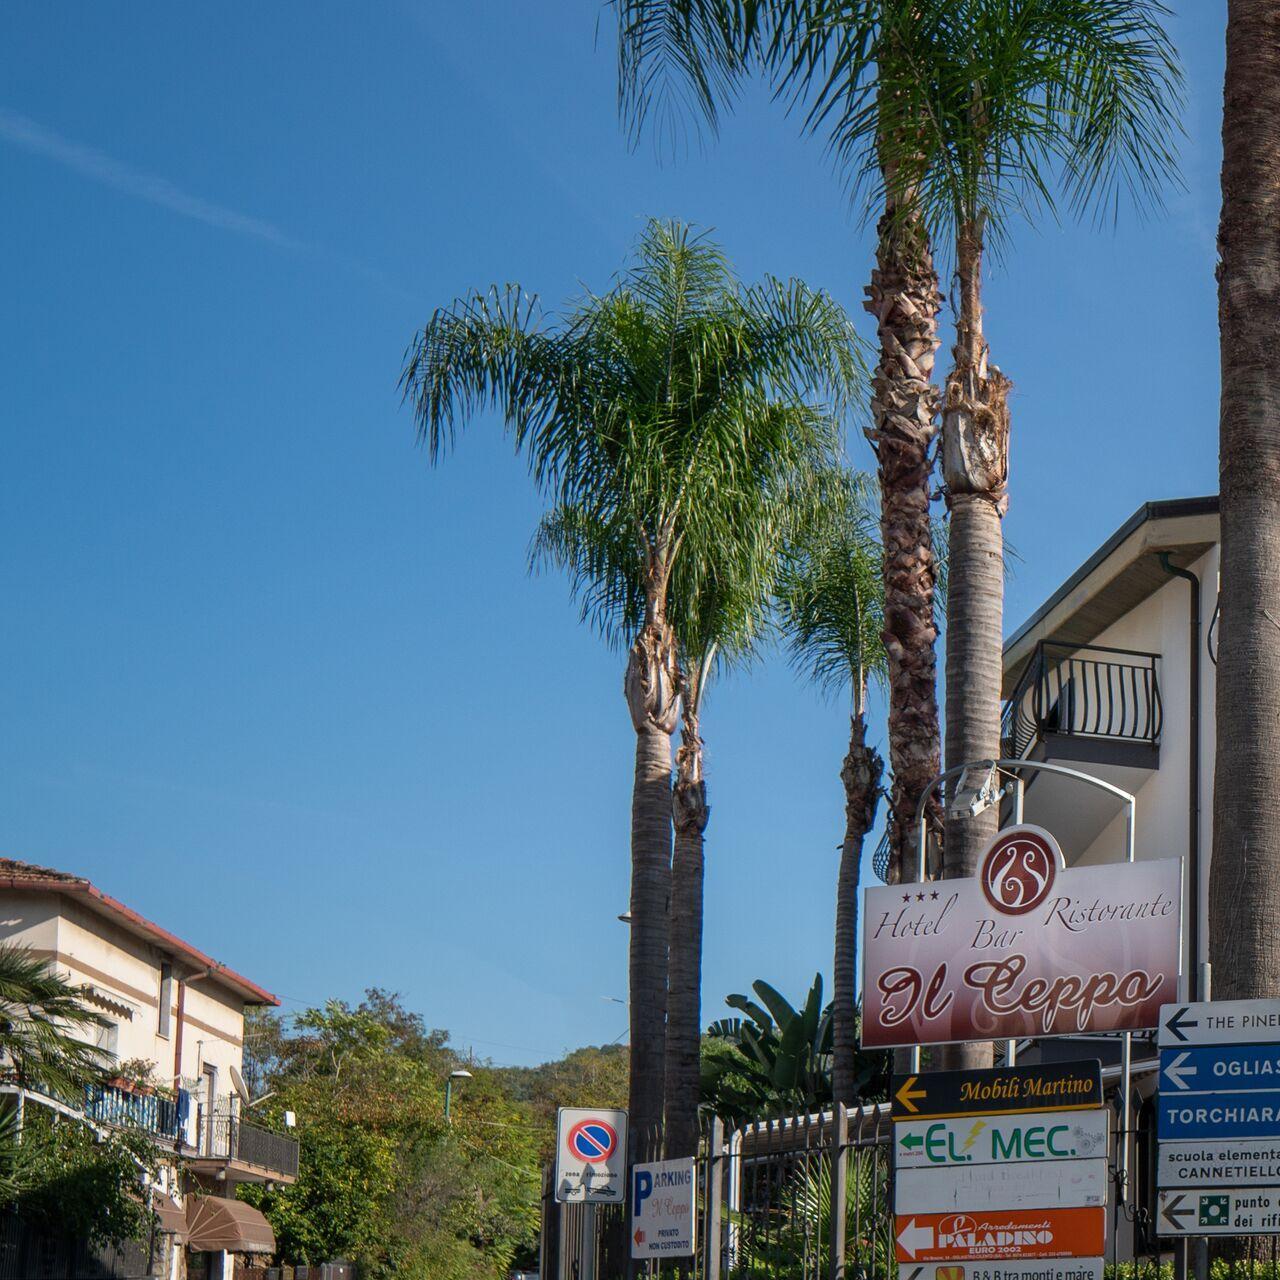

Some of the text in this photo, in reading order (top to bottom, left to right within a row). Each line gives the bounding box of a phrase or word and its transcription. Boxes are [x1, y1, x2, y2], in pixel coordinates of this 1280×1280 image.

[873, 893, 959, 940] Hotel
[1043, 893, 1176, 932] Ristorante
[970, 919, 1024, 950] Bar
[877, 954, 1164, 1032] Il Ceppo
[1207, 1015, 1235, 1029] THE
[960, 1074, 1093, 1101] Mobili Martino
[991, 1125, 1076, 1160] MEC.
[1168, 1151, 1214, 1162] scuola
[1234, 1196, 1270, 1210] punto
[978, 1220, 1051, 1231] Arredamenti
[1234, 1214, 1253, 1227] dei
[657, 1228, 679, 1238] PRIVATO
[938, 1231, 1053, 1248] PALADINO
[648, 1240, 689, 1251] NON CUSTODITO
[969, 1246, 995, 1254] EURO
[1056, 1272, 1062, 1280] e
[1065, 1270, 1094, 1280] mare
